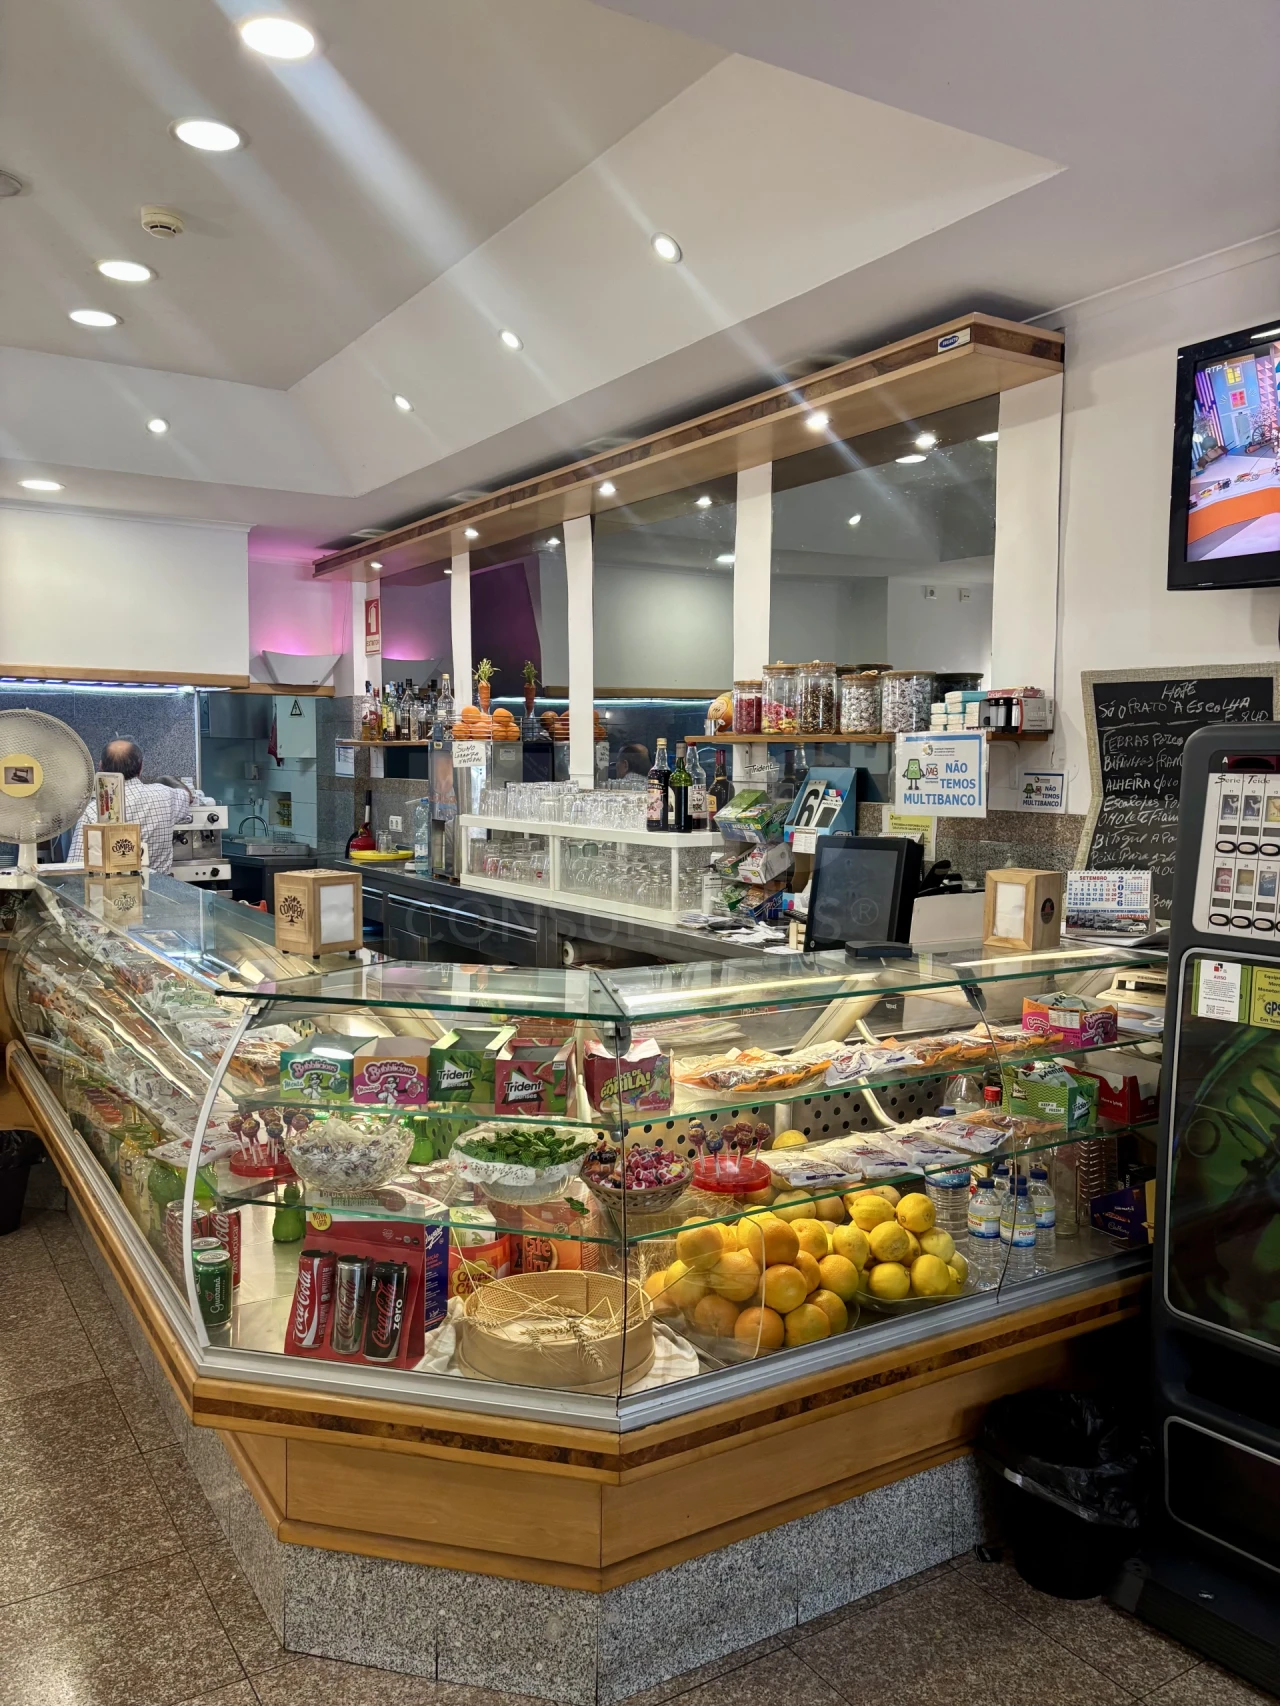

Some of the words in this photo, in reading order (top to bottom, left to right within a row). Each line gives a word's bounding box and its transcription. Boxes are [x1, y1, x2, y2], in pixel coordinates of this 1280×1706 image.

[1161, 681, 1198, 701] HOJE
[1128, 698, 1167, 714] PRATO
[1187, 697, 1250, 714] ESCOLHA
[946, 760, 968, 773] NÃO
[940, 778, 976, 789] TEMOS
[903, 793, 976, 806] MULTIBANCO
[290, 1059, 339, 1079] Bubblicious
[366, 1060, 416, 1082] Bubblicious
[437, 1069, 474, 1081] Trident
[504, 1080, 542, 1093] Trident
[294, 1270, 312, 1339] Coca-Cola
[372, 1280, 396, 1349] Coca-Cola
[393, 1299, 403, 1330] zero
